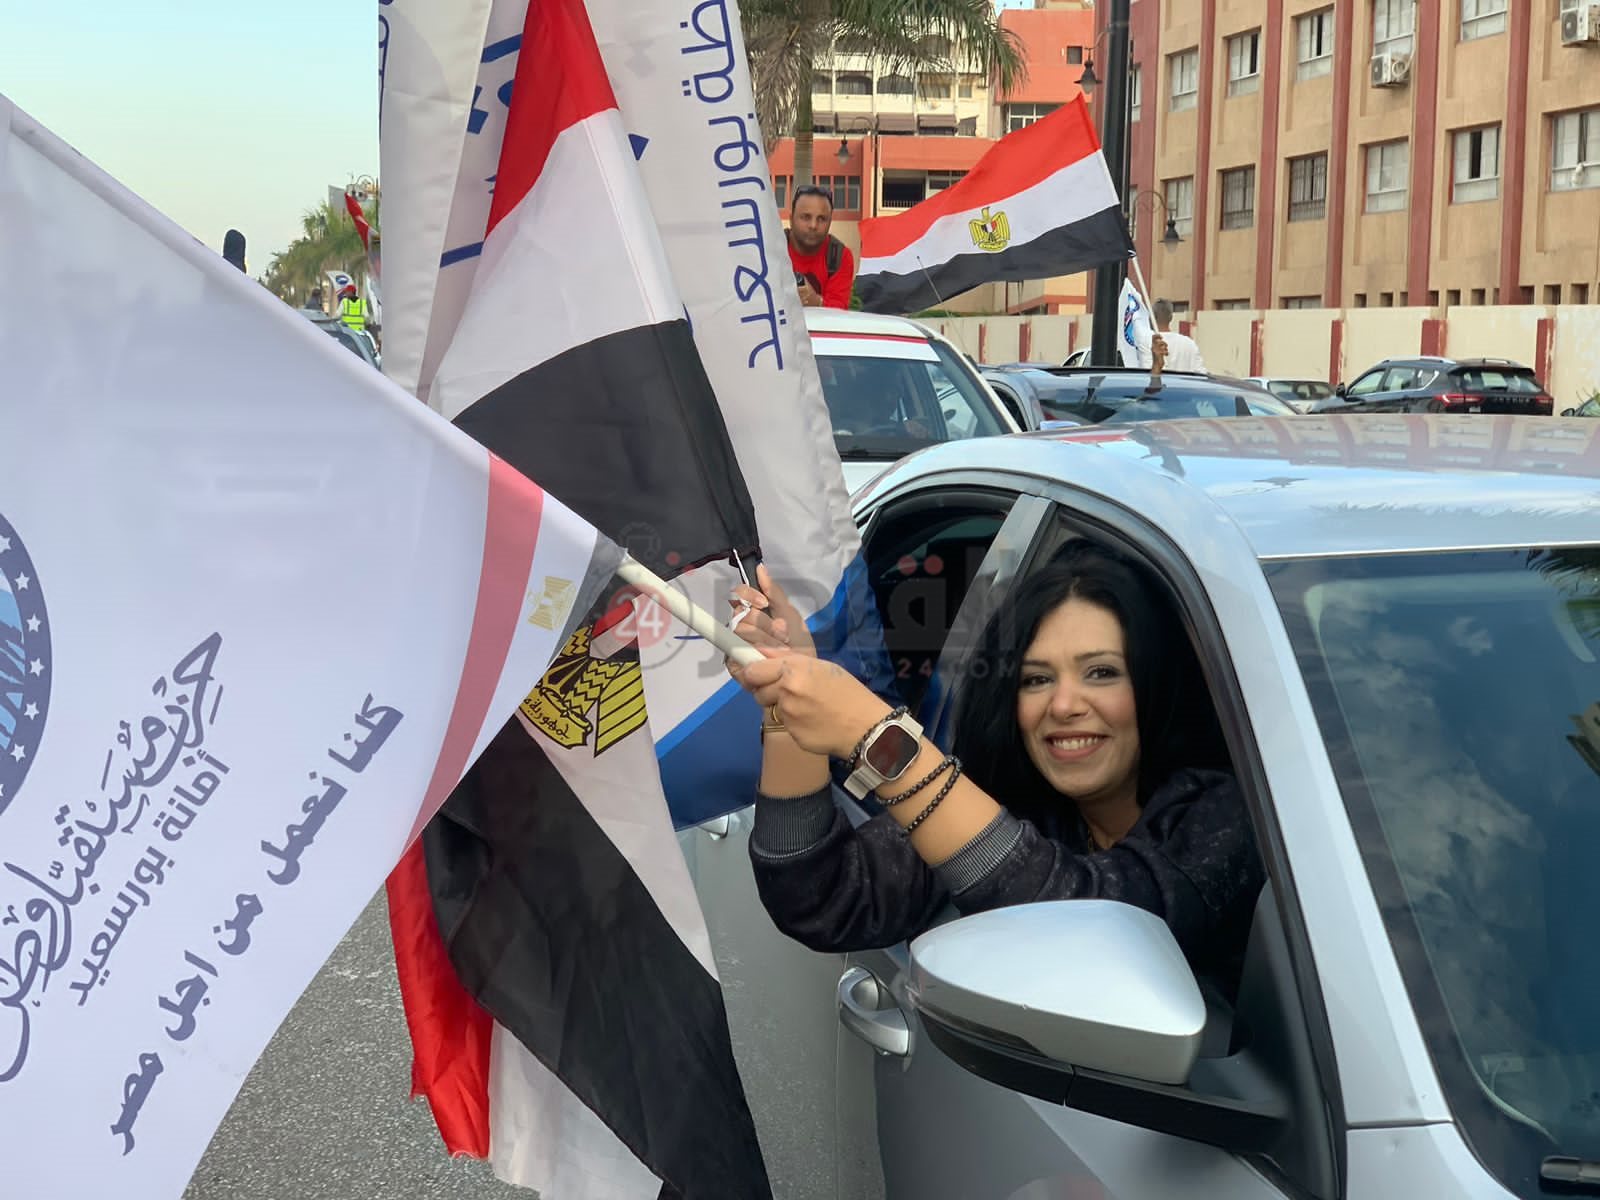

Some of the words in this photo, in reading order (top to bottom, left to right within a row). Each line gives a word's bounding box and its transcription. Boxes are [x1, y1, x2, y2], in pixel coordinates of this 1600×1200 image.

[708, 112, 787, 371] بورسعيد
[328, 692, 404, 774] كلنا
[151, 748, 230, 842] أمانة
[260, 771, 348, 885] نعمل
[69, 846, 175, 1006] بورسعيد
[213, 893, 264, 955] من
[158, 949, 219, 1041] اجل
[110, 1051, 164, 1156] مصر
